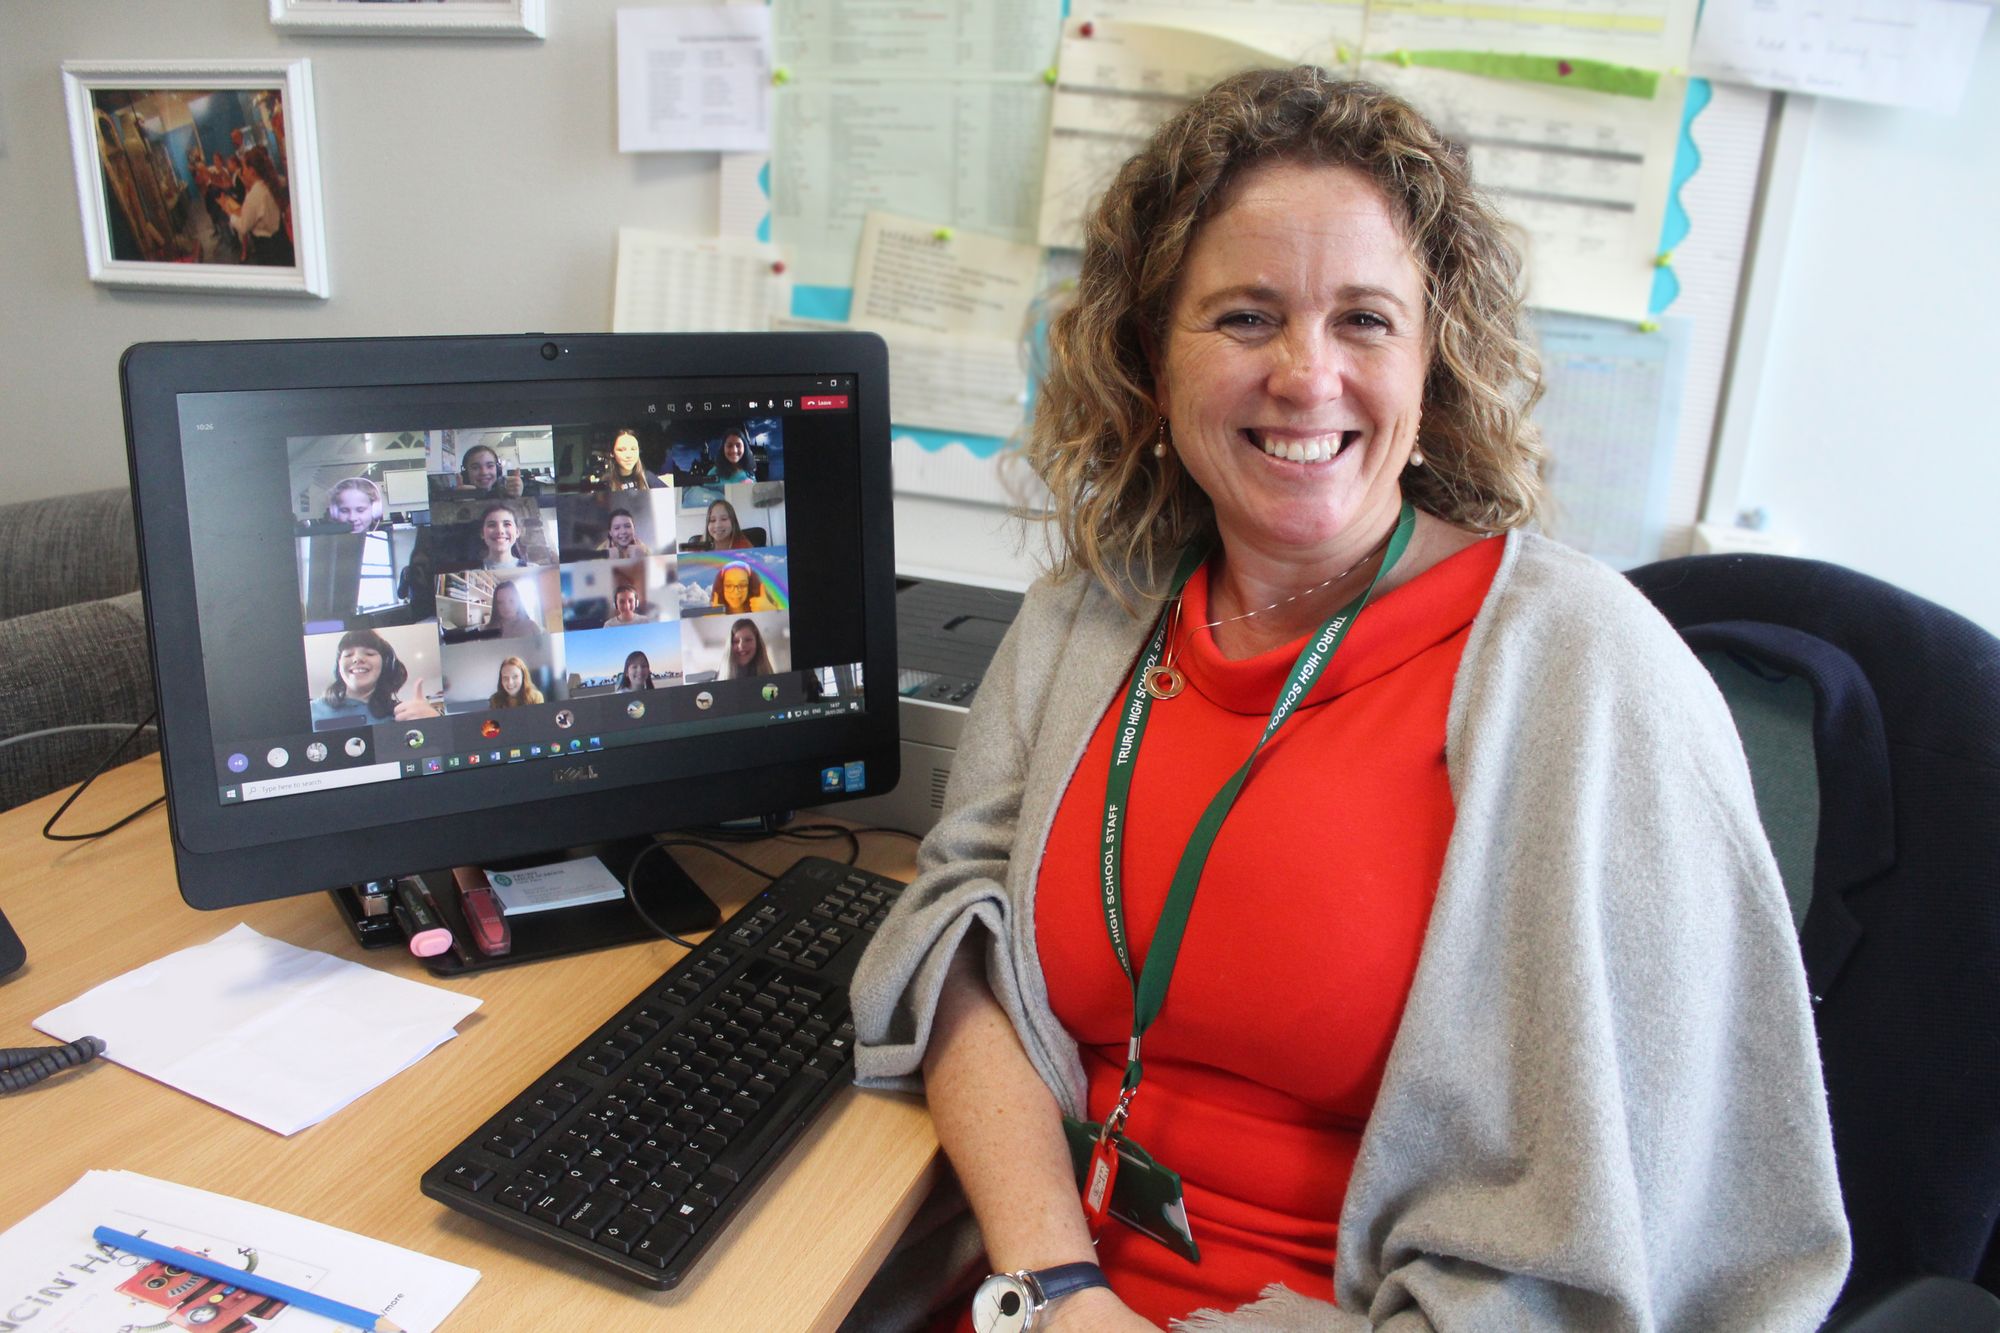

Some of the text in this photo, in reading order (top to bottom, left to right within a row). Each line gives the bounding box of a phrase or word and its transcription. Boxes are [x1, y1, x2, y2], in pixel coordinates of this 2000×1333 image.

[1267, 616, 1348, 731] TRURO HIGH SCHOOL
[1116, 727, 1136, 766] TRURO
[1127, 699, 1144, 726] HIGH
[1104, 804, 1121, 944] HIGH SCHOOL STAFF
[590, 1148, 603, 1157] W
[651, 1181, 662, 1189] Z
